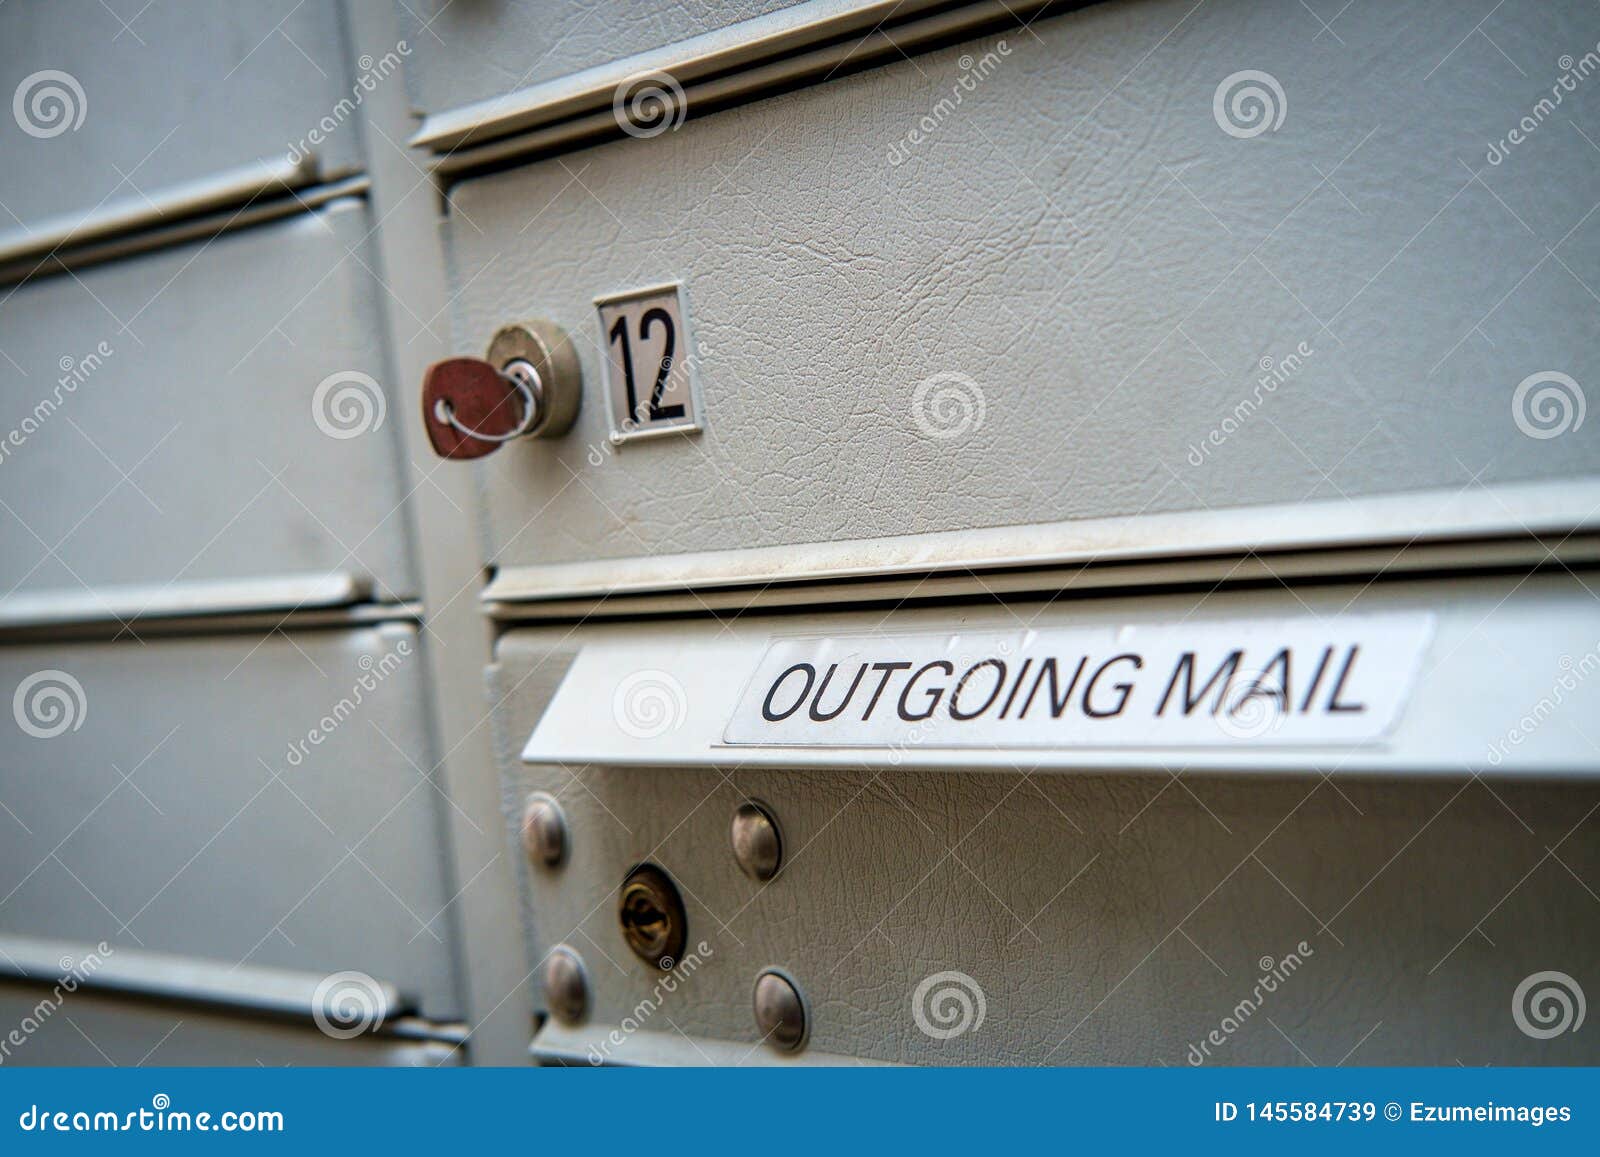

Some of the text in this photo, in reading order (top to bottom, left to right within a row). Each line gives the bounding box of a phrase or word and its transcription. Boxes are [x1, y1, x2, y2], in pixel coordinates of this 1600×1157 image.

[609, 307, 685, 424] 12
[761, 644, 1367, 722] OUTGOING MAIL
